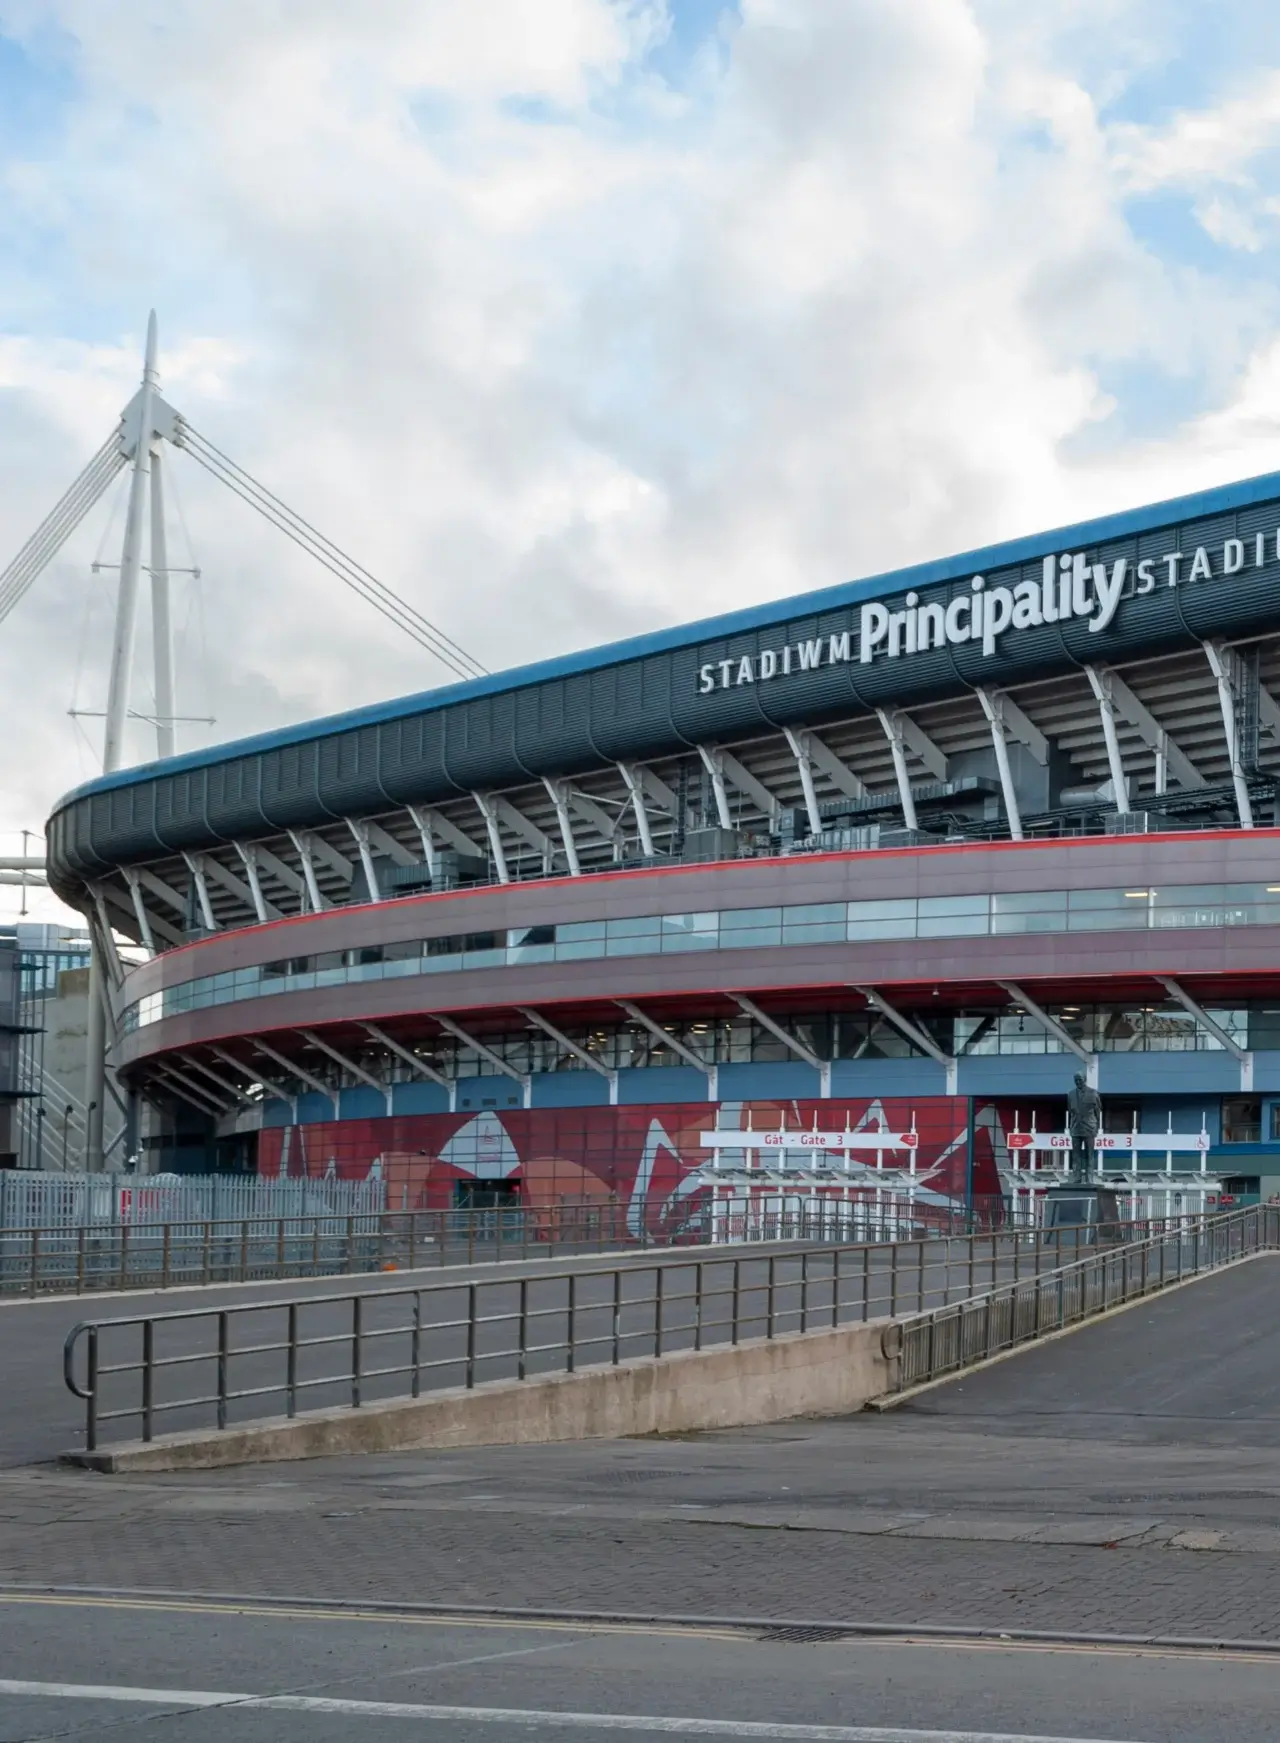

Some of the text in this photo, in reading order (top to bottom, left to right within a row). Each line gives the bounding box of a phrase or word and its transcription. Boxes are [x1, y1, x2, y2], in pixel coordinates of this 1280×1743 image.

[700, 631, 850, 694] STADIWM
[860, 553, 1128, 664] Principality
[764, 1133, 784, 1145] Gât
[800, 1134, 826, 1145] Gate
[836, 1135, 844, 1145] 3
[1096, 1137, 1115, 1147] ate
[1126, 1137, 1133, 1147] 3
